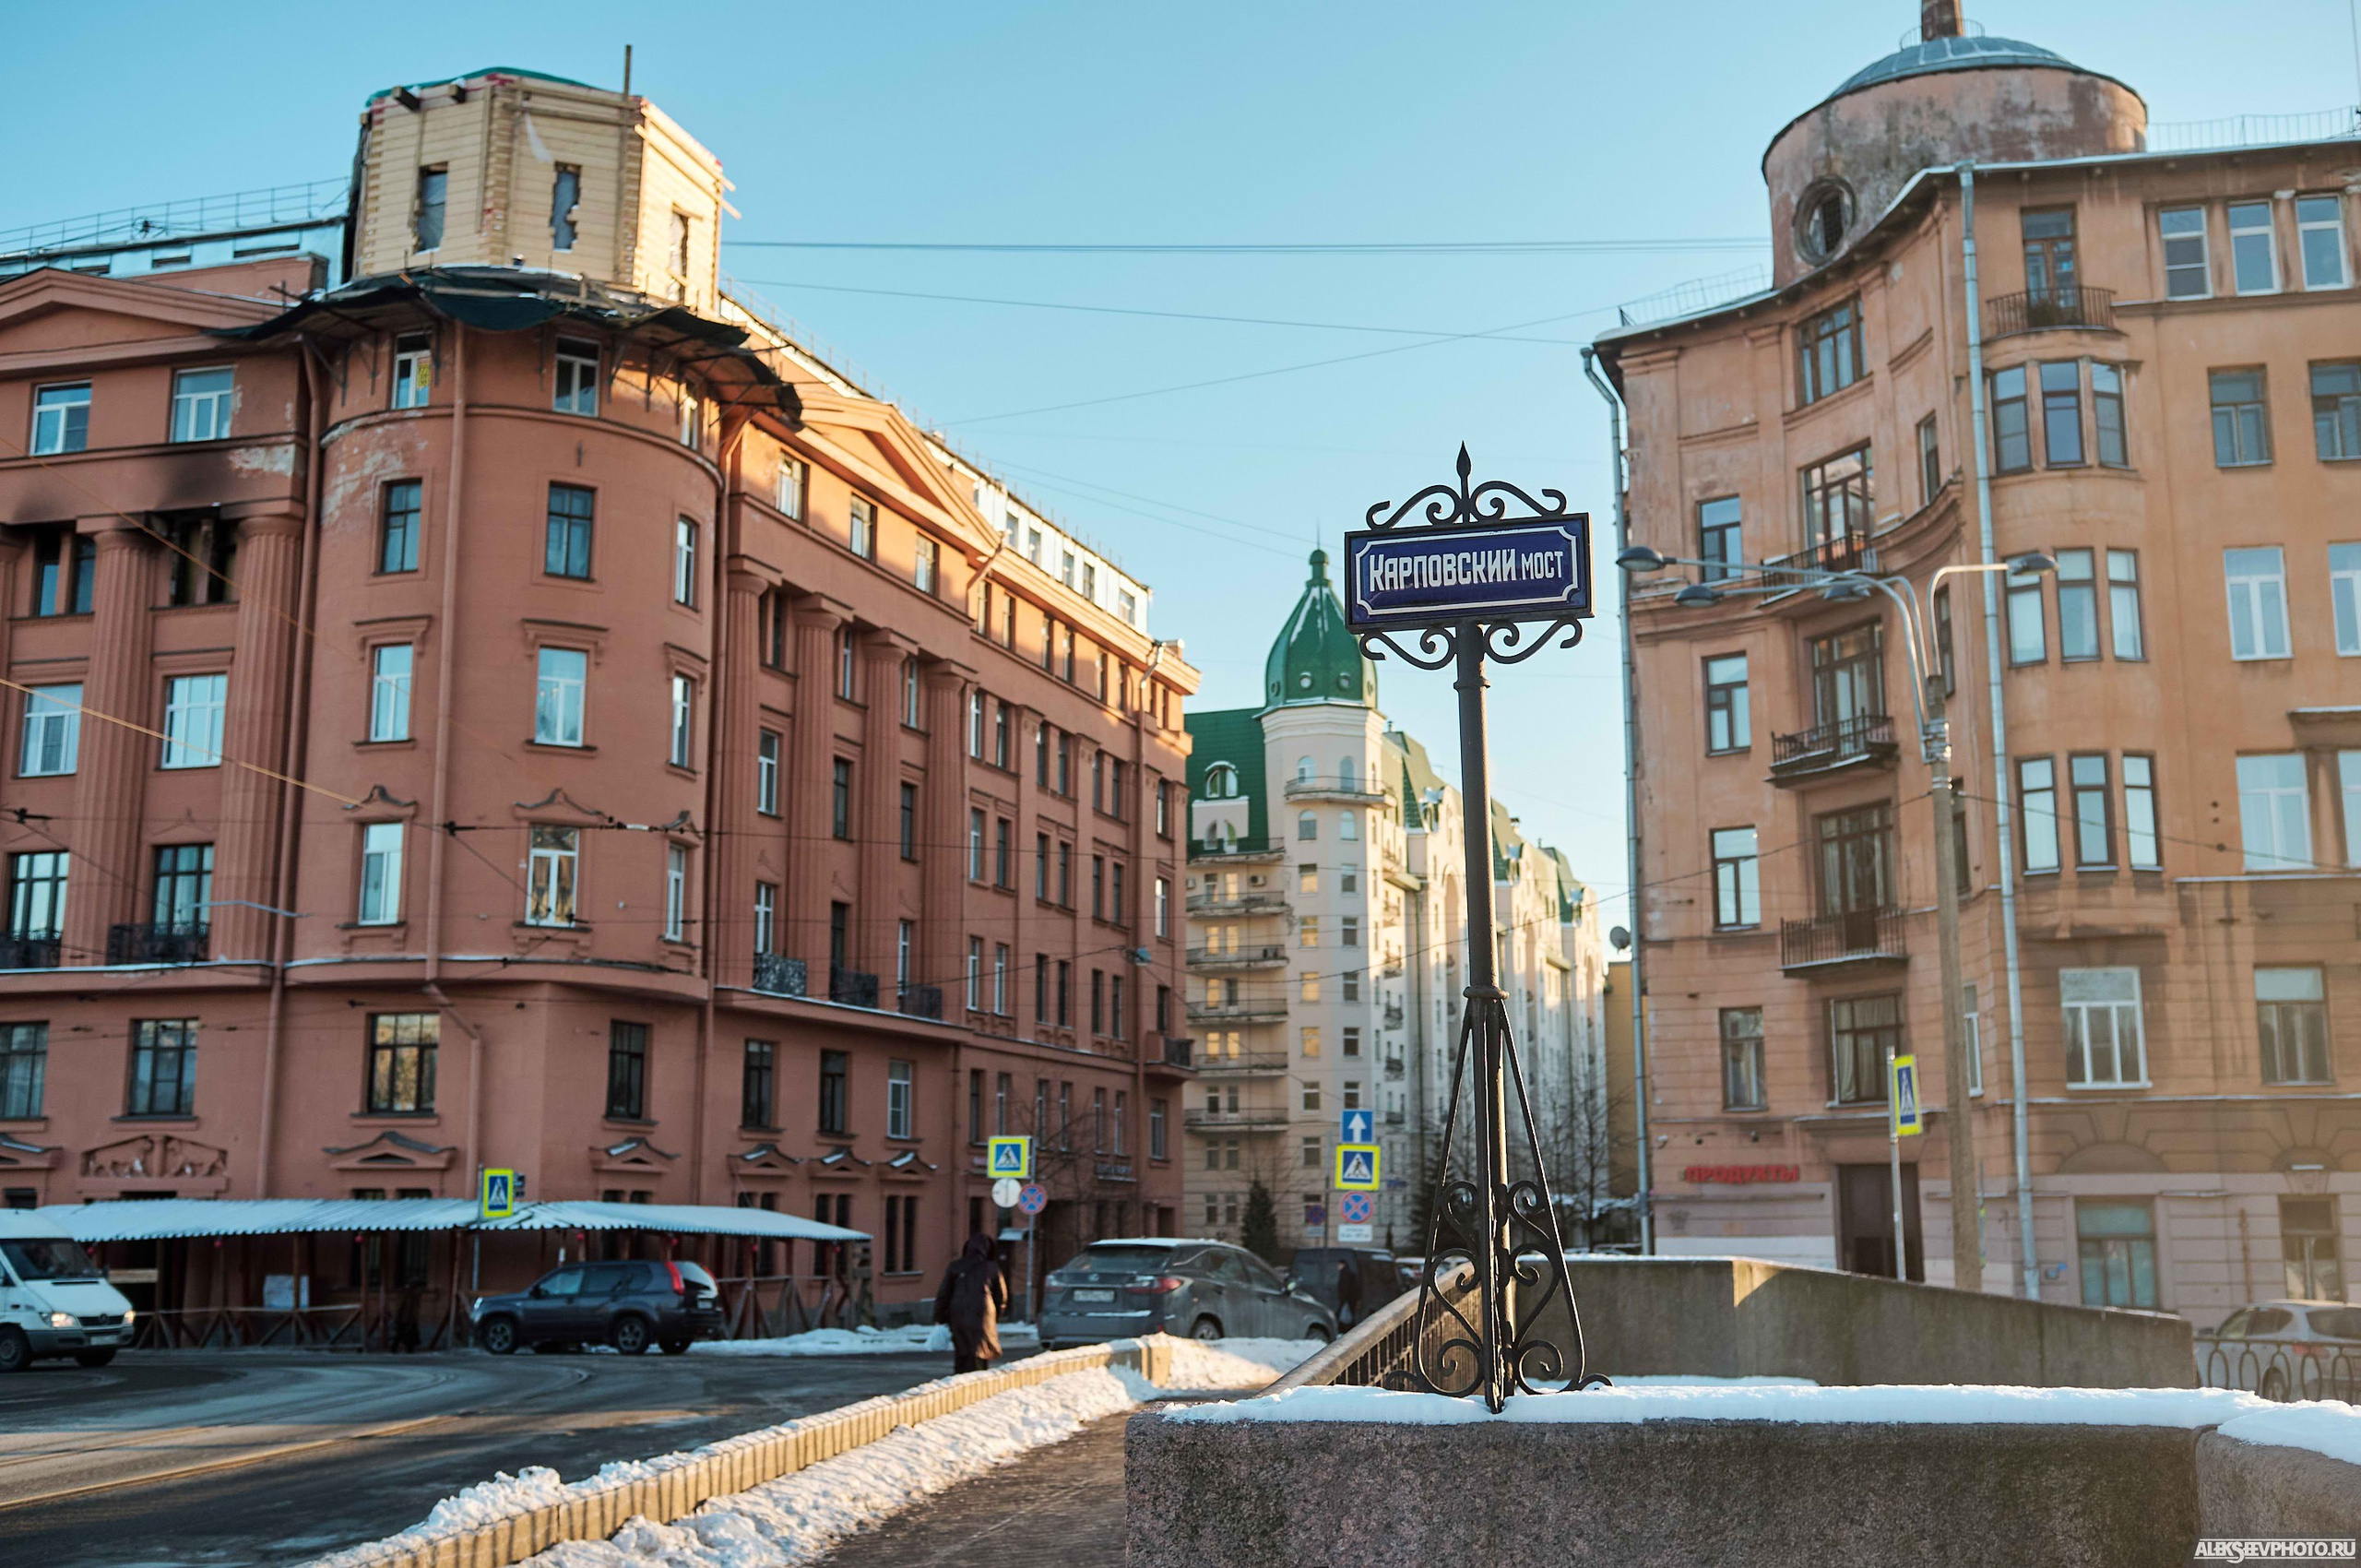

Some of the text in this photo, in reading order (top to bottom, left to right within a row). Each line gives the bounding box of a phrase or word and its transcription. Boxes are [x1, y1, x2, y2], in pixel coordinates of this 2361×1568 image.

[1370, 548, 1563, 591] КАРПОВСКИЙ МОСТ
[1686, 1164, 1798, 1183] ПРОДУКТЫ
